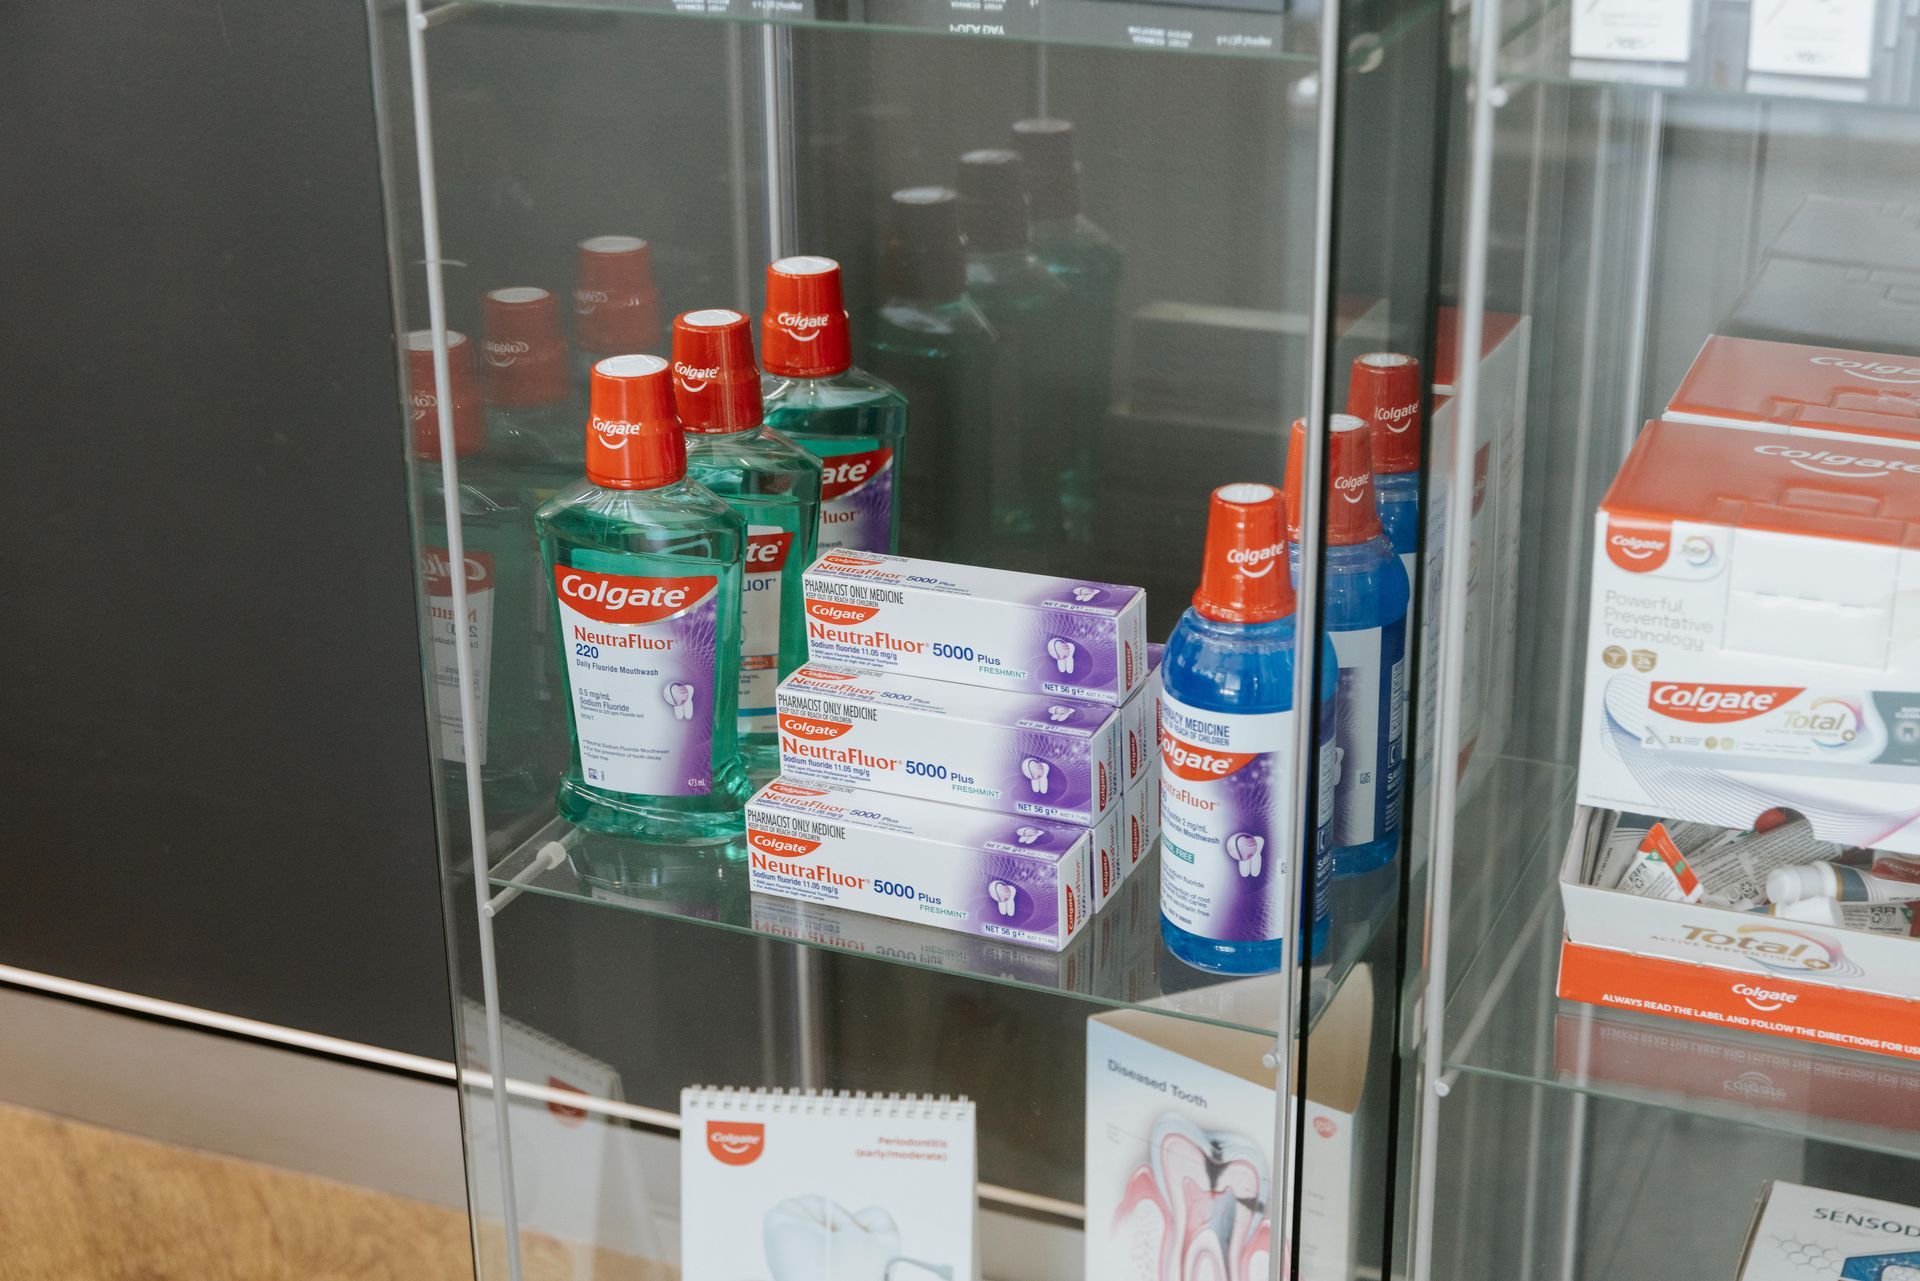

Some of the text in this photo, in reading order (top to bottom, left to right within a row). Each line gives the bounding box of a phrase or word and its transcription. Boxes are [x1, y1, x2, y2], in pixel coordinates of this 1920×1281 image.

[777, 312, 828, 330] Colgate
[674, 361, 718, 379] Colgate
[1810, 357, 1920, 375] Colga
[1377, 403, 1418, 421] Colgate
[592, 416, 640, 436] Colgate
[1753, 445, 1920, 473] Colgate
[1334, 473, 1368, 491] Colgate
[1611, 535, 1665, 550] Colgate
[1227, 542, 1283, 565] Colgate
[817, 563, 938, 584] NeutraFluor 5000
[562, 574, 686, 610] Colgate
[805, 580, 904, 604] PHARMACIST ONLY MEDICINE
[811, 604, 865, 622] Colgate
[856, 599, 879, 608] CHILDREN
[1604, 606, 1713, 633] Preventative
[574, 625, 674, 650] NeutraFluor
[809, 622, 1000, 666] NeutraFluor 5000 Plus
[1604, 622, 1704, 651] Technology
[576, 643, 599, 659] 220
[810, 640, 834, 650] Sodium
[836, 643, 860, 654] fluoride
[861, 648, 879, 657] 11.05
[880, 650, 897, 661] mg/g
[576, 659, 658, 676] Daily Fluoride Mouthwash
[979, 666, 1027, 679] FRESHMINT
[579, 688, 611, 701] 0.5 mg/mL
[791, 677, 912, 700] NeutraFluor 5000
[1044, 681, 1059, 691] NET
[580, 697, 601, 708] Sodium
[603, 701, 629, 712] Fluoride
[778, 694, 878, 721] PHARMACIST ONLY MEDICINE
[1653, 685, 1773, 712] Colgate
[807, 711, 821, 719] REACH
[829, 715, 852, 723] CHILDREN
[1784, 710, 1846, 731] Total
[785, 719, 838, 737] Colgate
[1186, 717, 1230, 738] MEDICINE
[1198, 733, 1230, 746] CHILDREN
[782, 736, 974, 784] NeutraFluor 5000 Plus
[783, 754, 807, 765] Sodium
[808, 759, 833, 769] fluoride
[834, 764, 851, 773] 11.05
[853, 767, 870, 777] mg/g
[687, 779, 697, 787] 473
[774, 785, 815, 796] Colgate
[952, 784, 1000, 798] FRESHMINT
[761, 791, 881, 820] NeutraFluor 5000
[1018, 803, 1032, 811] NET
[747, 810, 846, 840] PHARMACIST ONLY MEDICINE
[776, 827, 790, 835] REACH
[798, 832, 821, 842] CHILDREN
[754, 835, 807, 853] Colgate
[1183, 828, 1220, 844] Mouthwash
[751, 852, 865, 890] NeutraFluor
[874, 879, 915, 900] 5000
[918, 892, 942, 905] Plus
[752, 869, 776, 880] Sodium
[777, 874, 801, 886] fluoride
[802, 880, 820, 890] 11.05
[821, 884, 838, 895] mg/g
[920, 904, 967, 919] FRESHMINT
[985, 925, 999, 934] NET
[1650, 935, 1797, 963] ACTIVE PREVENTION
[1682, 924, 1810, 957] Total
[1731, 983, 1797, 1004] Colgate
[1602, 994, 1920, 1055] ALWAYS READ THE LABEL AND FOLLOW THE DIRECTIONS FOR US
[1107, 1058, 1208, 1109] Diseased Tooth
[711, 1132, 760, 1145] Colgate
[878, 1136, 948, 1148] Periodontitis
[1813, 1206, 1920, 1237] SENSOD
